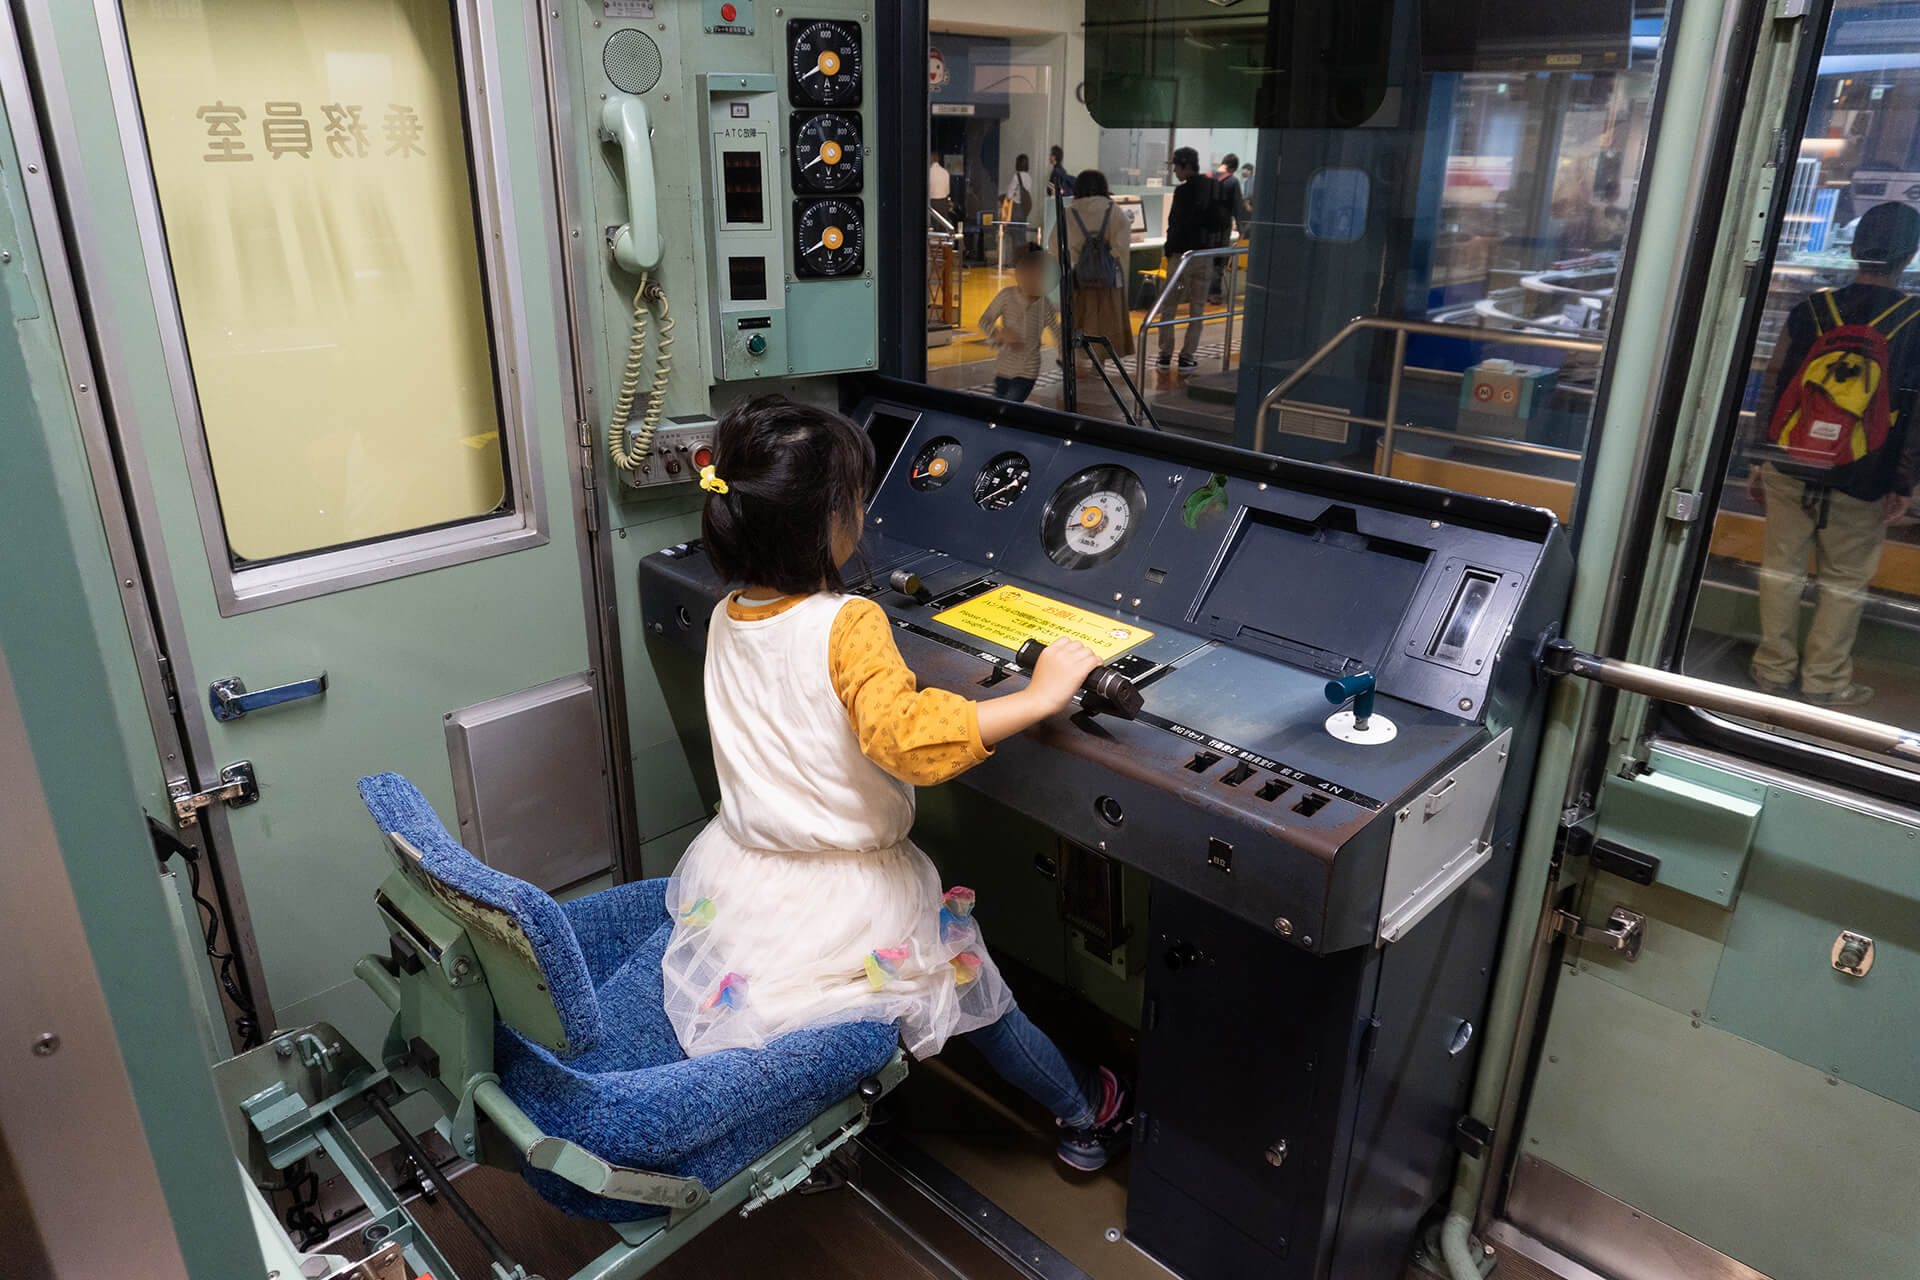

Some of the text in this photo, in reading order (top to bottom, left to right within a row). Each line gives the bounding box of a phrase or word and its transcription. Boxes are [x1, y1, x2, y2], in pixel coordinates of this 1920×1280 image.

[800, 43, 811, 51] 500
[824, 78, 831, 88] A
[800, 145, 811, 153] 200
[825, 167, 832, 177] V
[828, 206, 838, 214] 100
[843, 247, 854, 255] 200
[1042, 606, 1084, 623] お願い
[960, 610, 982, 620] Please
[991, 622, 1015, 632] careful
[1318, 783, 1343, 794] 4N
